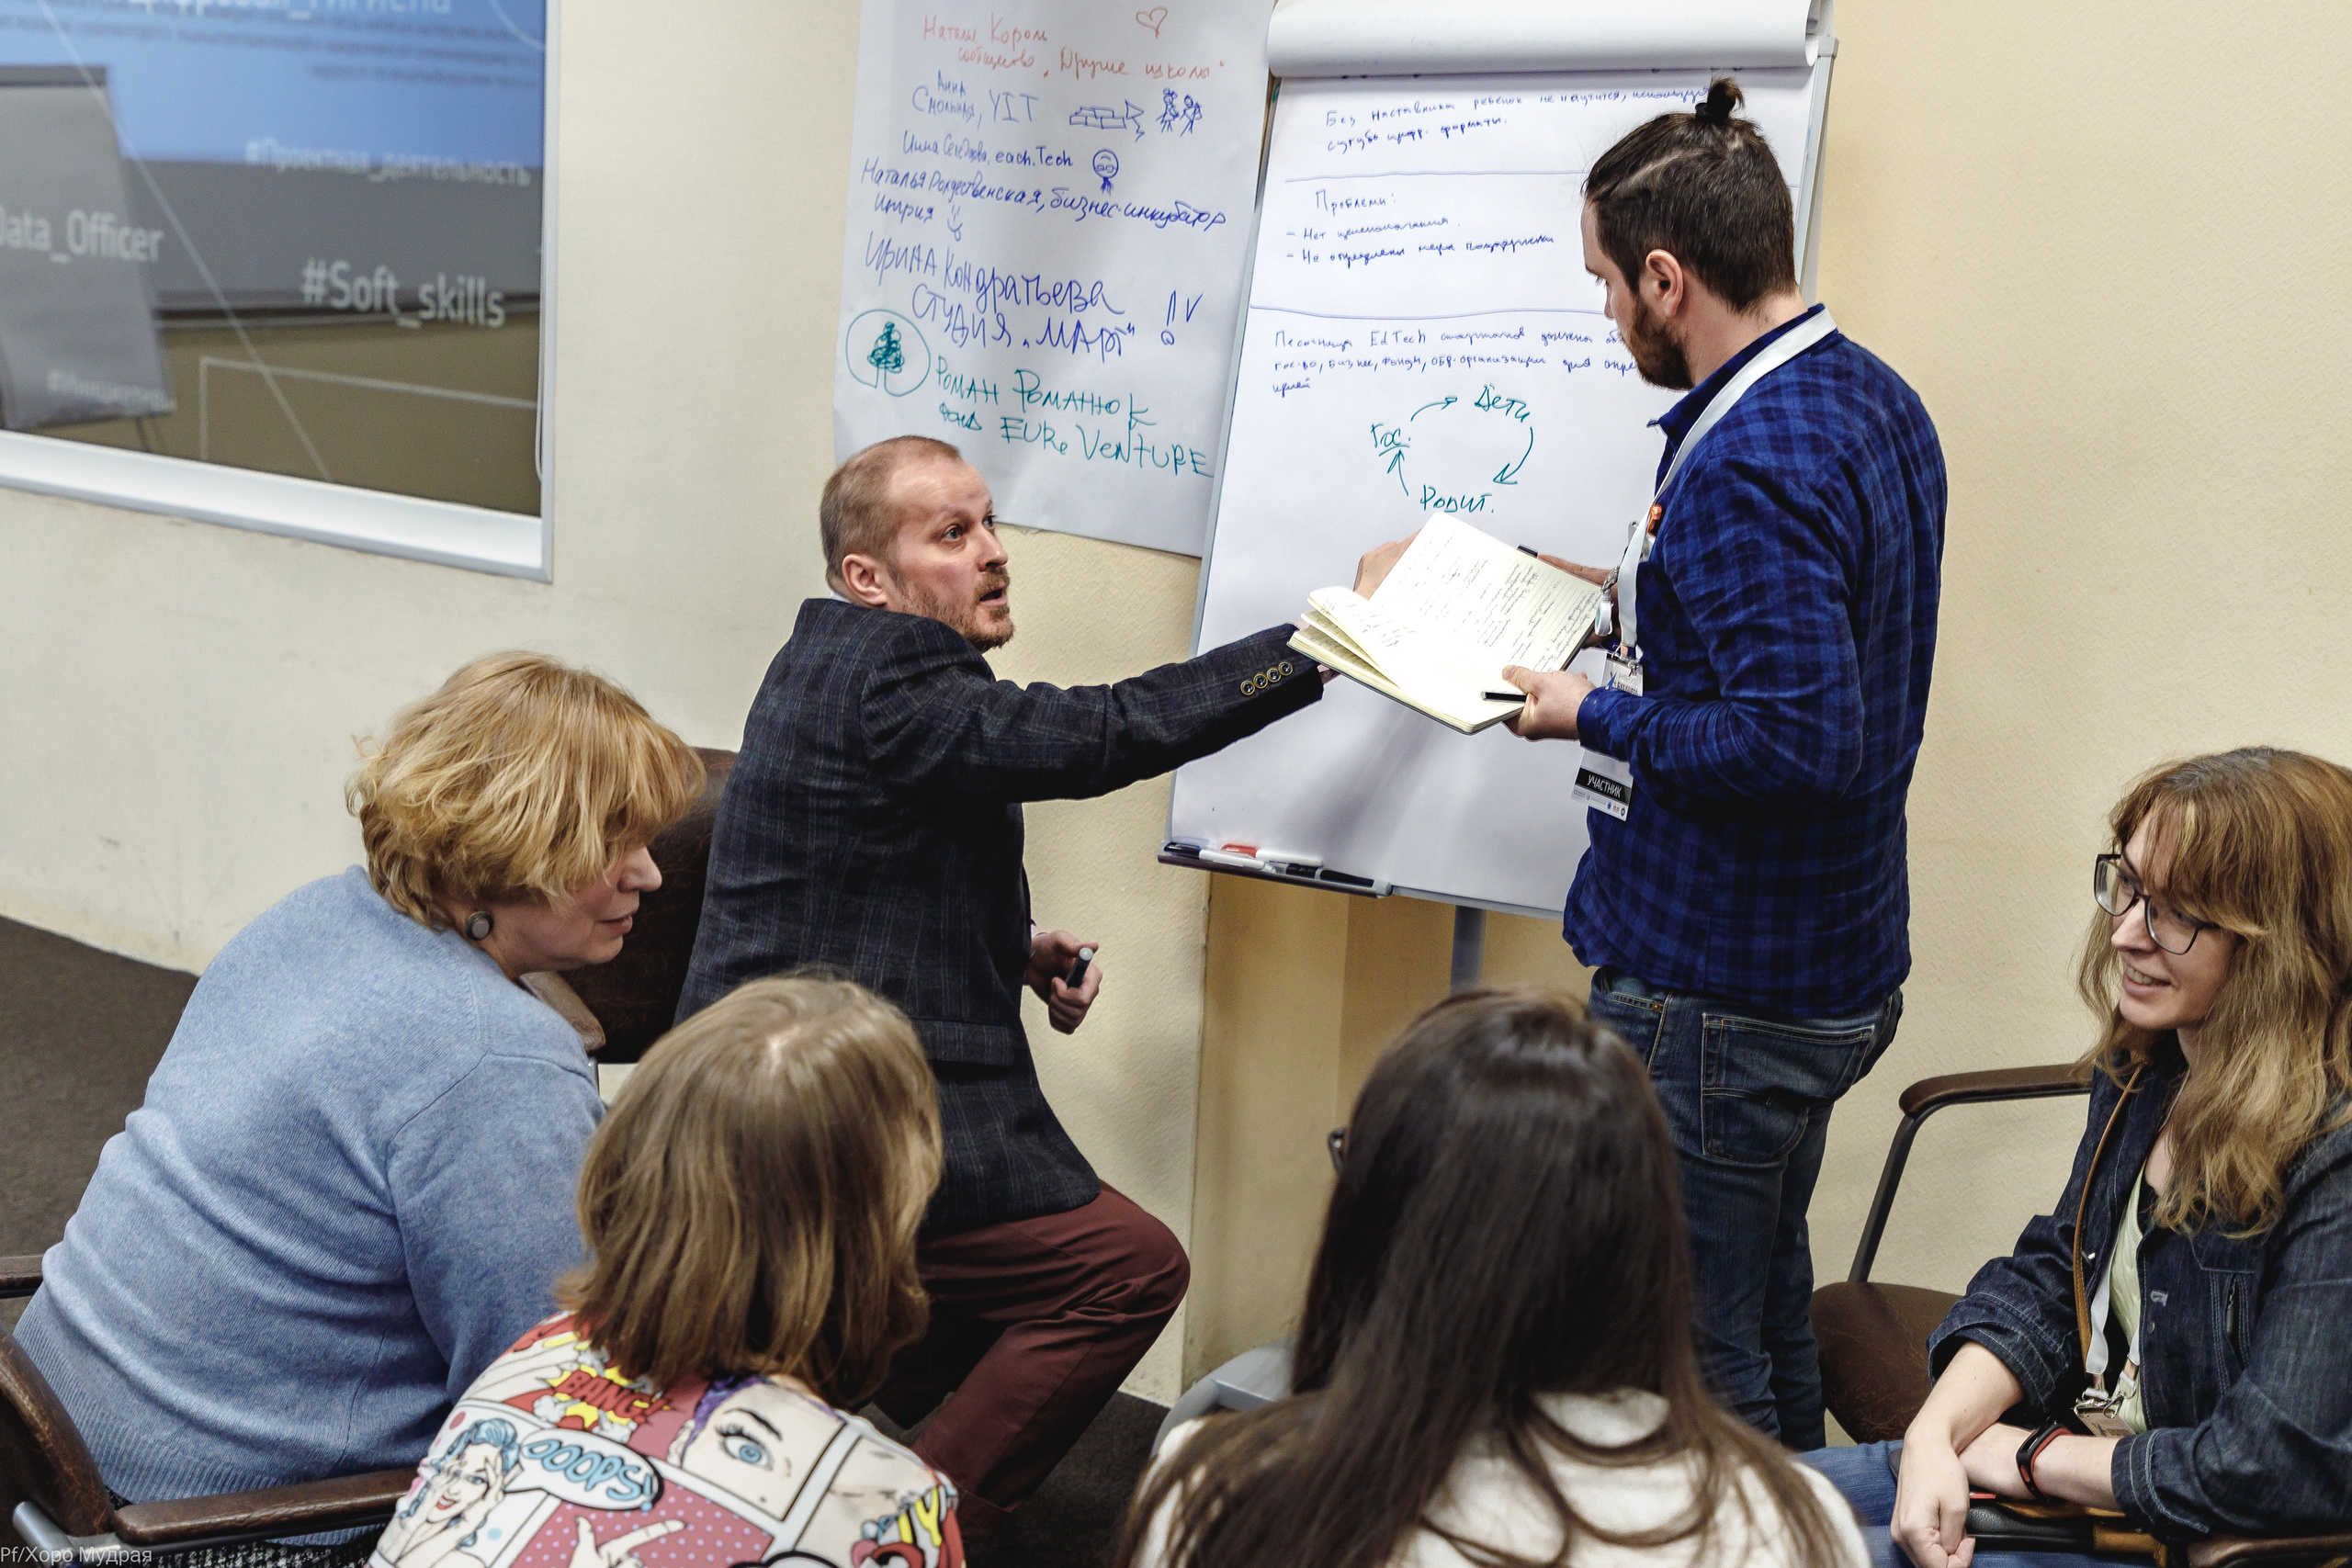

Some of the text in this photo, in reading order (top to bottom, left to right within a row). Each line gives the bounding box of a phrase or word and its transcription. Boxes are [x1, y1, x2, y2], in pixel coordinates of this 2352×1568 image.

[989, 87, 1040, 124] YIT
[861, 156, 927, 189] Наталья
[301, 257, 505, 329] #Soft_skills
[1587, 773, 1623, 798] УЧАСТНИК
[554, 1369, 669, 1424] BANG!
